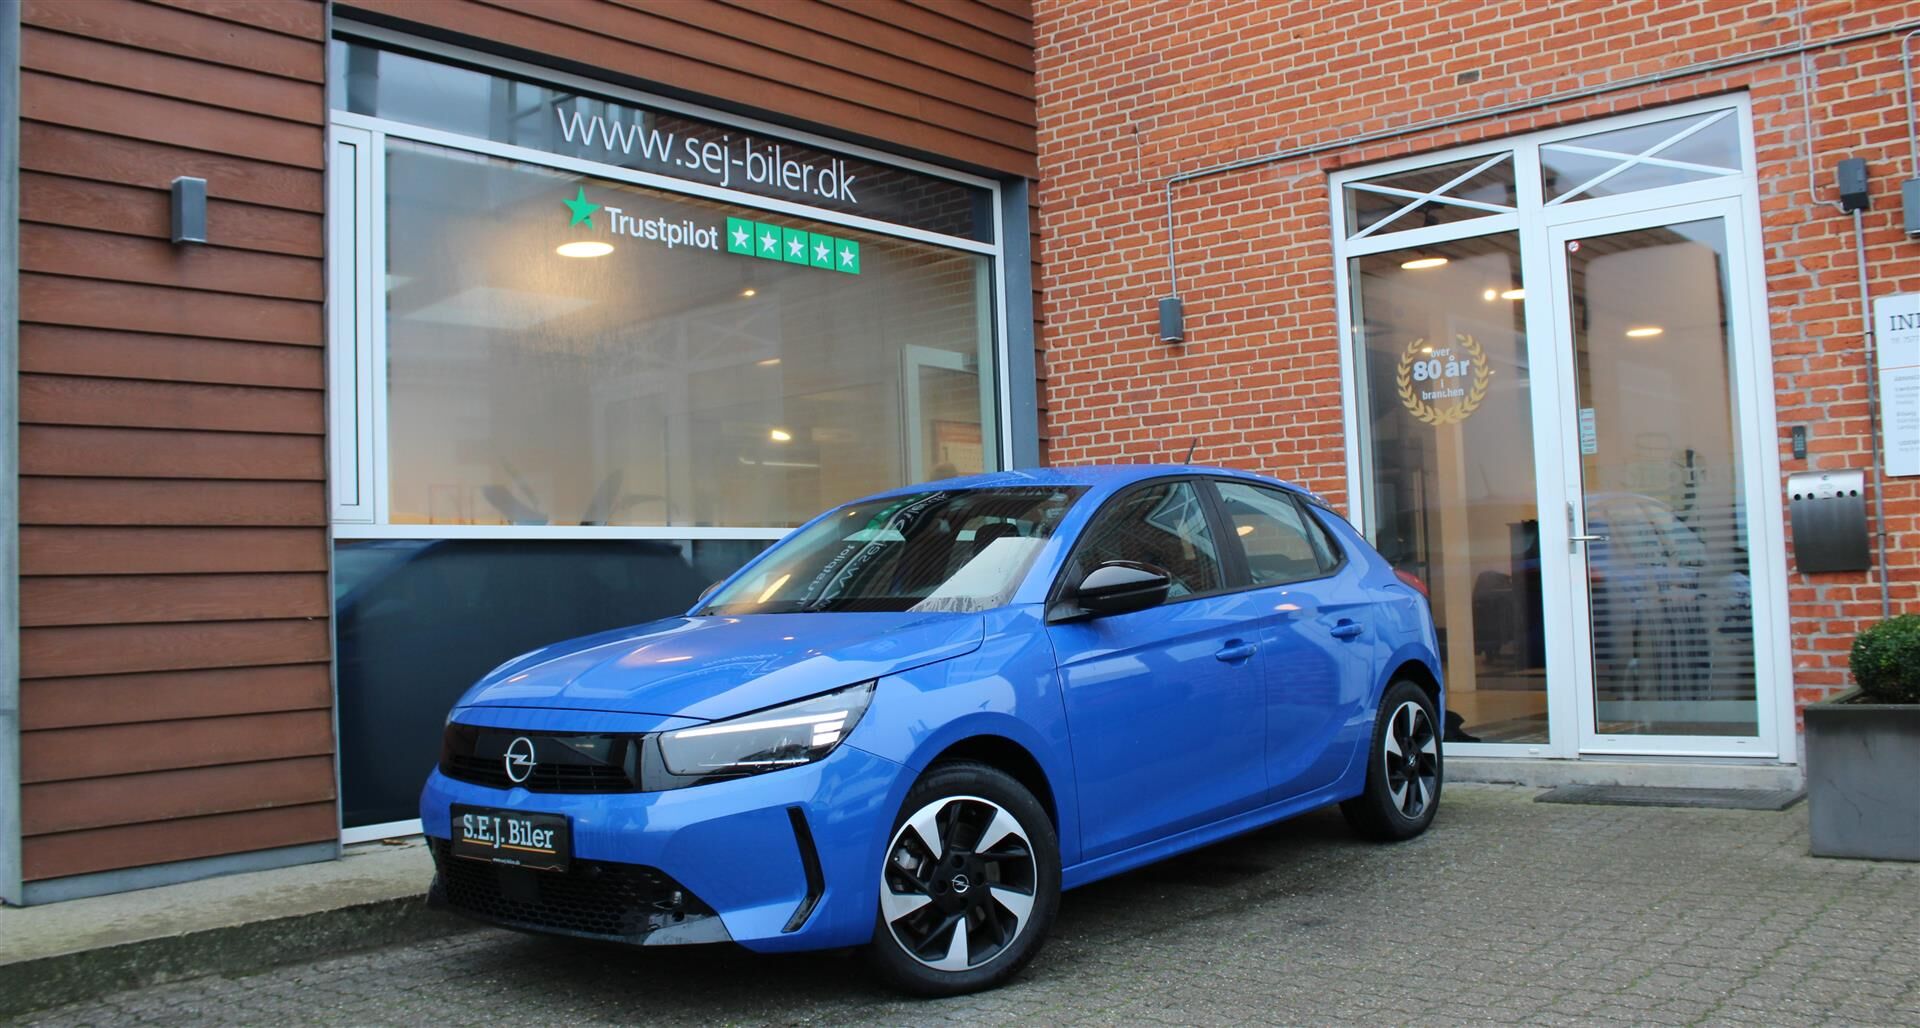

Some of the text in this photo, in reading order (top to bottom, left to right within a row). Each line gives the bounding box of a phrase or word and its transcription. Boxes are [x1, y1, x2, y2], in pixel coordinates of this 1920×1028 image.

[556, 107, 858, 203] www.sej-biler.dk
[604, 206, 719, 251] Trustpilot
[1413, 355, 1470, 381] 80 år
[1430, 347, 1451, 358] over
[463, 813, 554, 849] S.E.J. Biler
